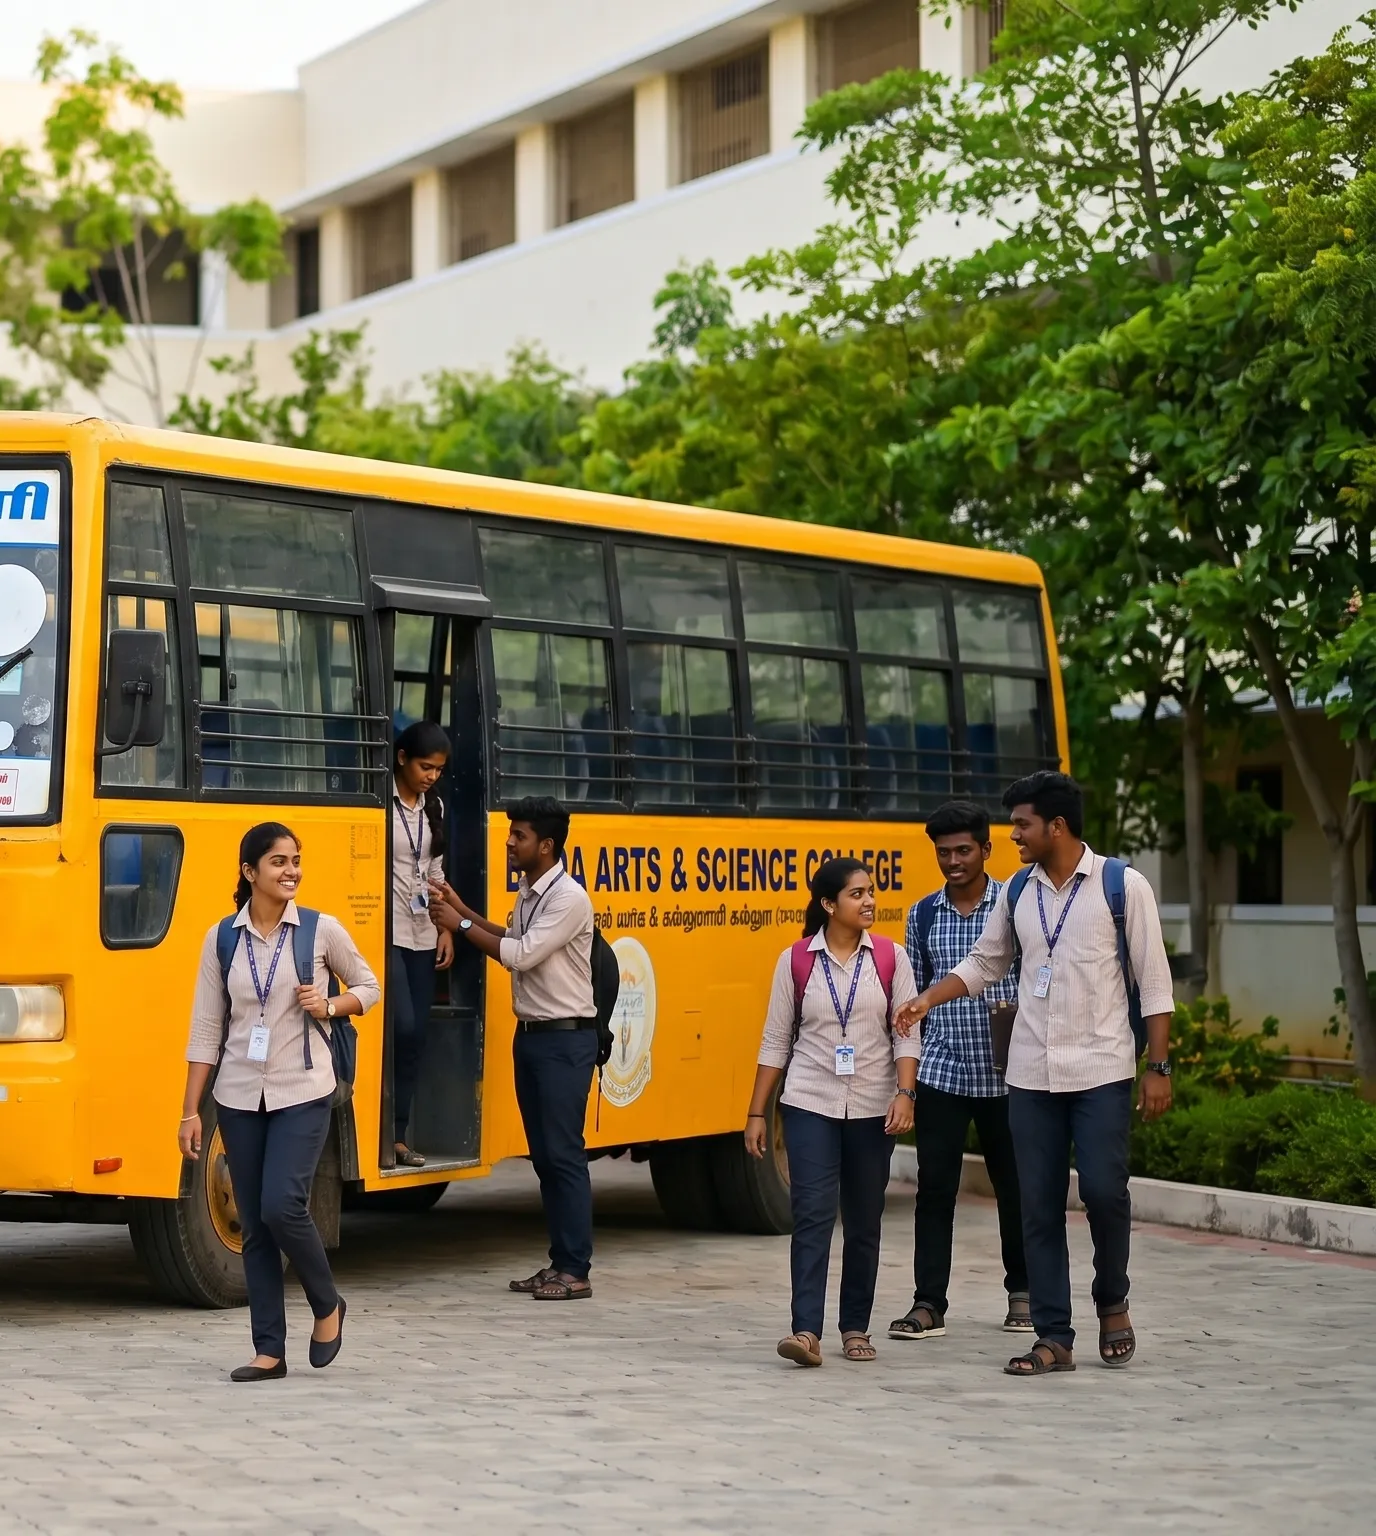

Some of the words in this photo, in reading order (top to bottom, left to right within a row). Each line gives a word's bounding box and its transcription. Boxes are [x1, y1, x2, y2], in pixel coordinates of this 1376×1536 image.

[594, 847, 662, 893] ARTS
[671, 847, 688, 893] &
[696, 847, 798, 893] SCIENCE
